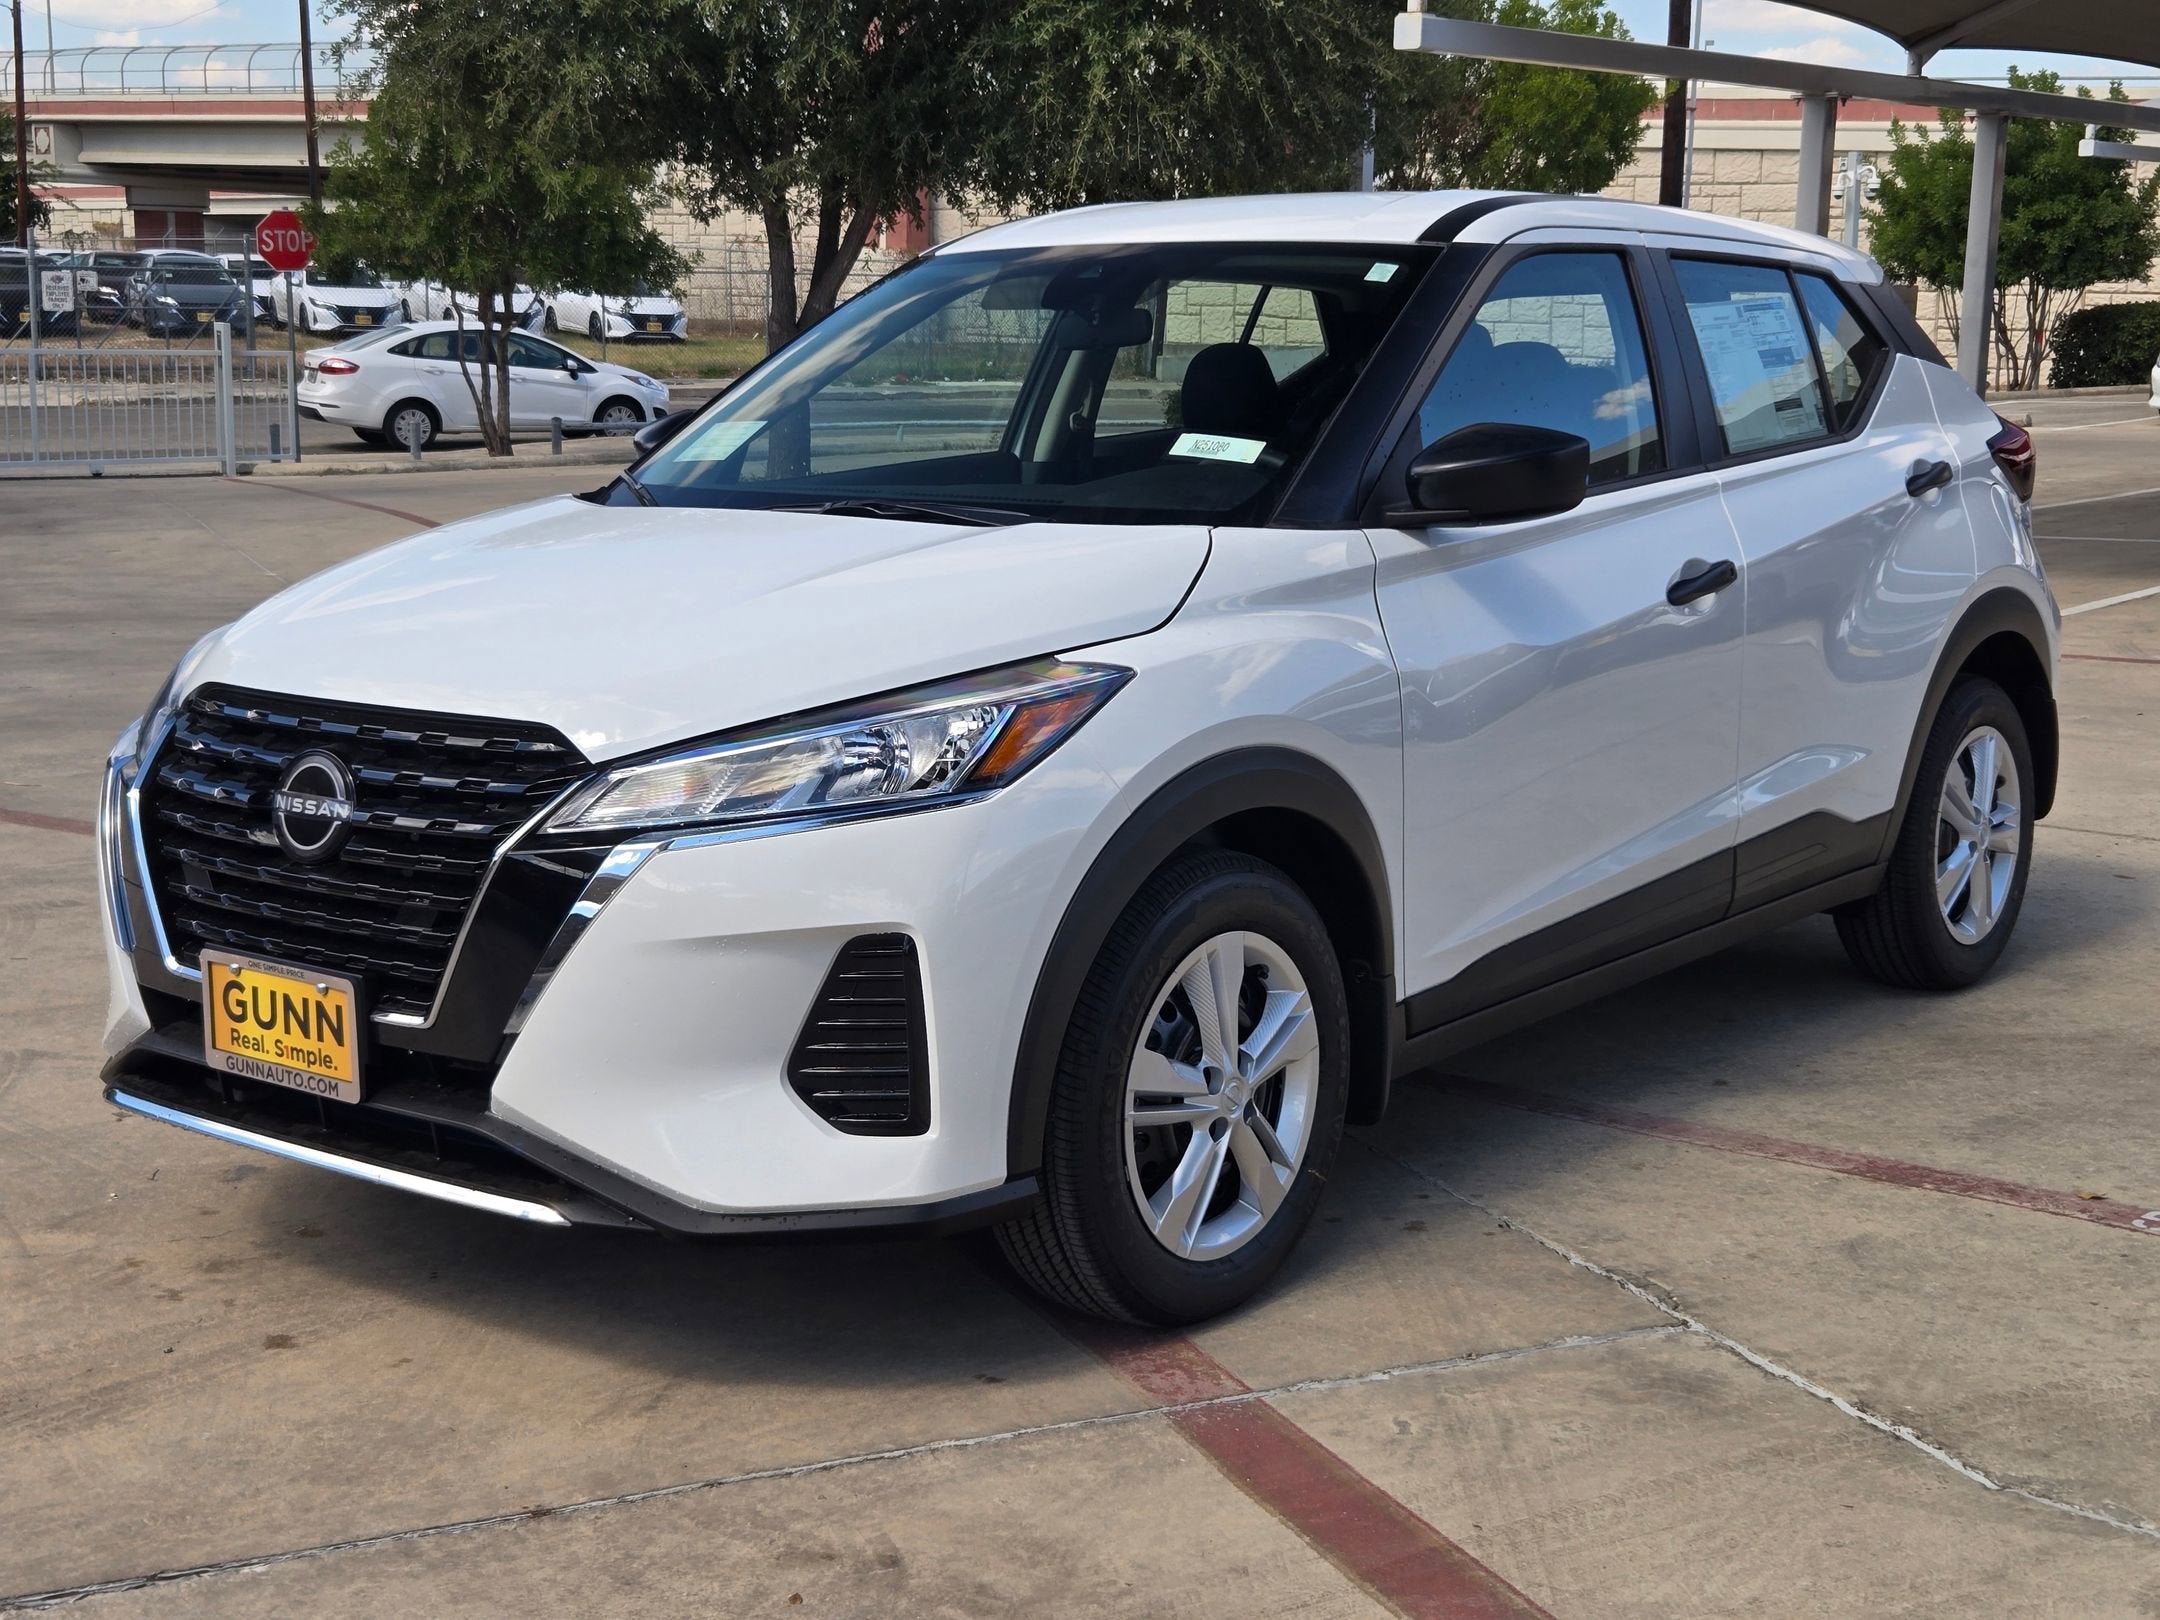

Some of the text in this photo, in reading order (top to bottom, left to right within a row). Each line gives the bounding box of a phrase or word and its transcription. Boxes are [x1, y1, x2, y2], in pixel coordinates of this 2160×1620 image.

[262, 230, 313, 252] STOP
[276, 794, 350, 818] NISSAN
[248, 960, 305, 978] ONE SIMPLE PRICE
[222, 980, 345, 1047] GUNN
[230, 1028, 270, 1055] Real.
[225, 1055, 340, 1098] GUNNAUTO.COM
